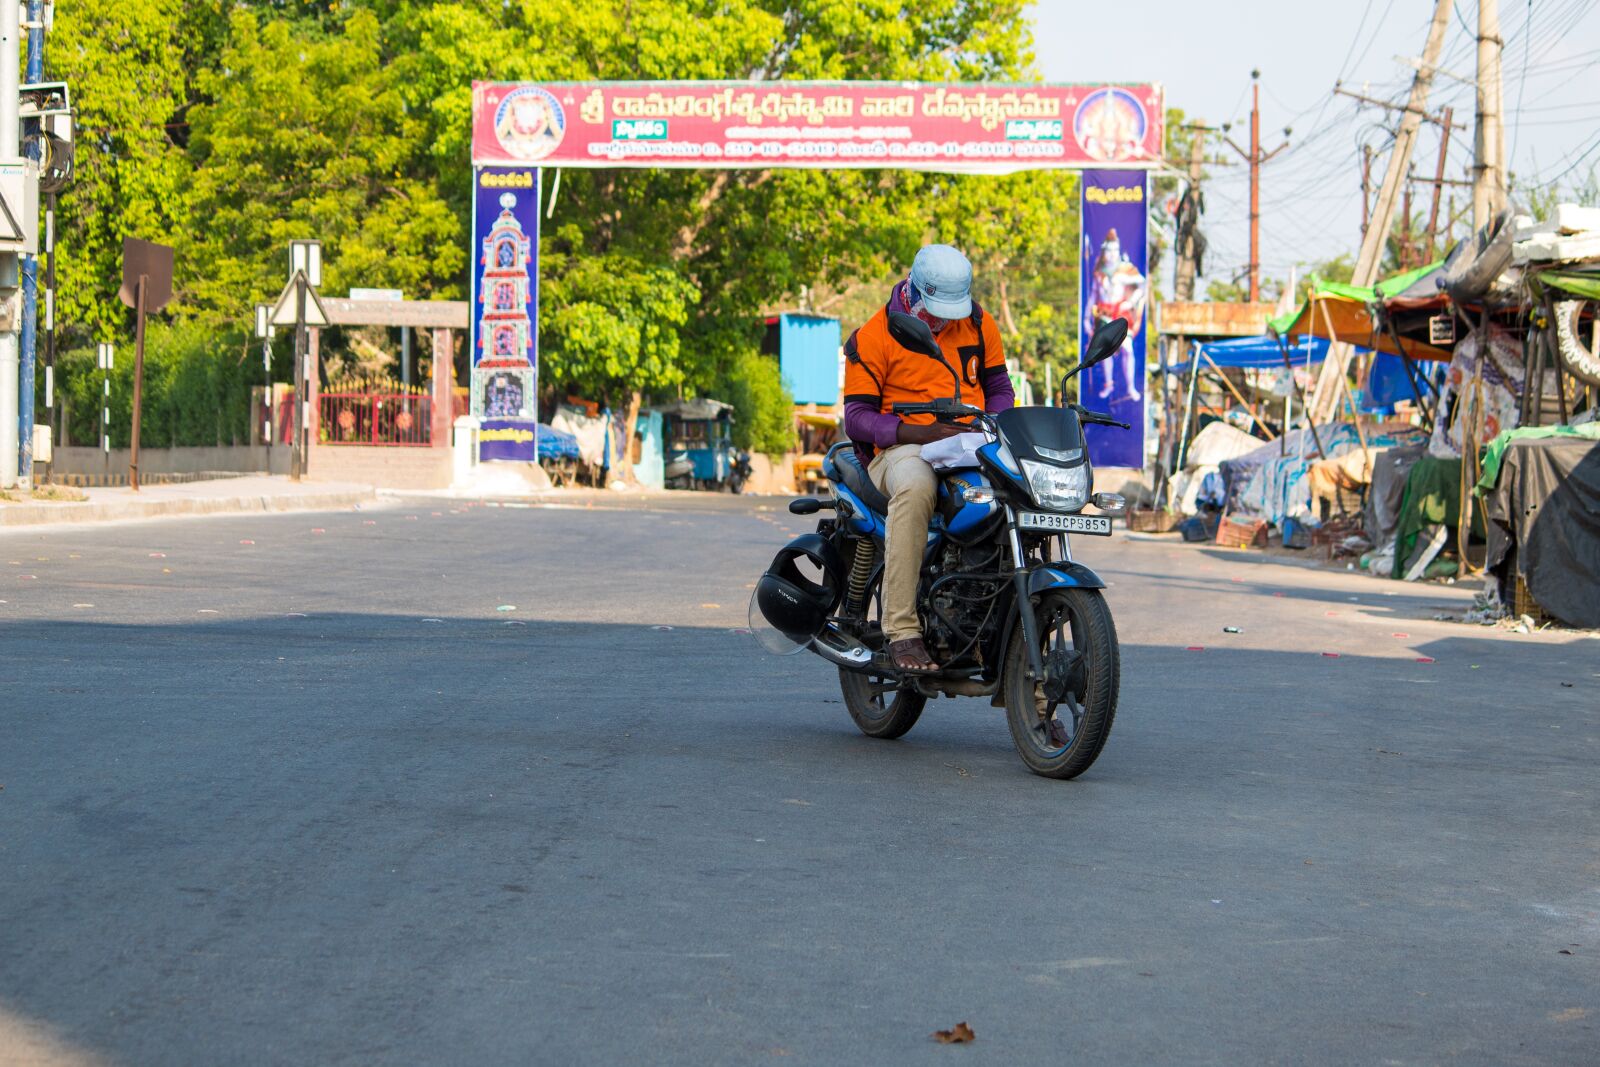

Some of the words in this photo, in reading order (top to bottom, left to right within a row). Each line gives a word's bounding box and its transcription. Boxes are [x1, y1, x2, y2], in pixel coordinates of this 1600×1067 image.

[580, 89, 604, 123] శ్రీ
[860, 96, 914, 116] వారి
[921, 88, 1059, 131] దేవస్థానము
[1032, 515, 1107, 530] AP39CP5859
